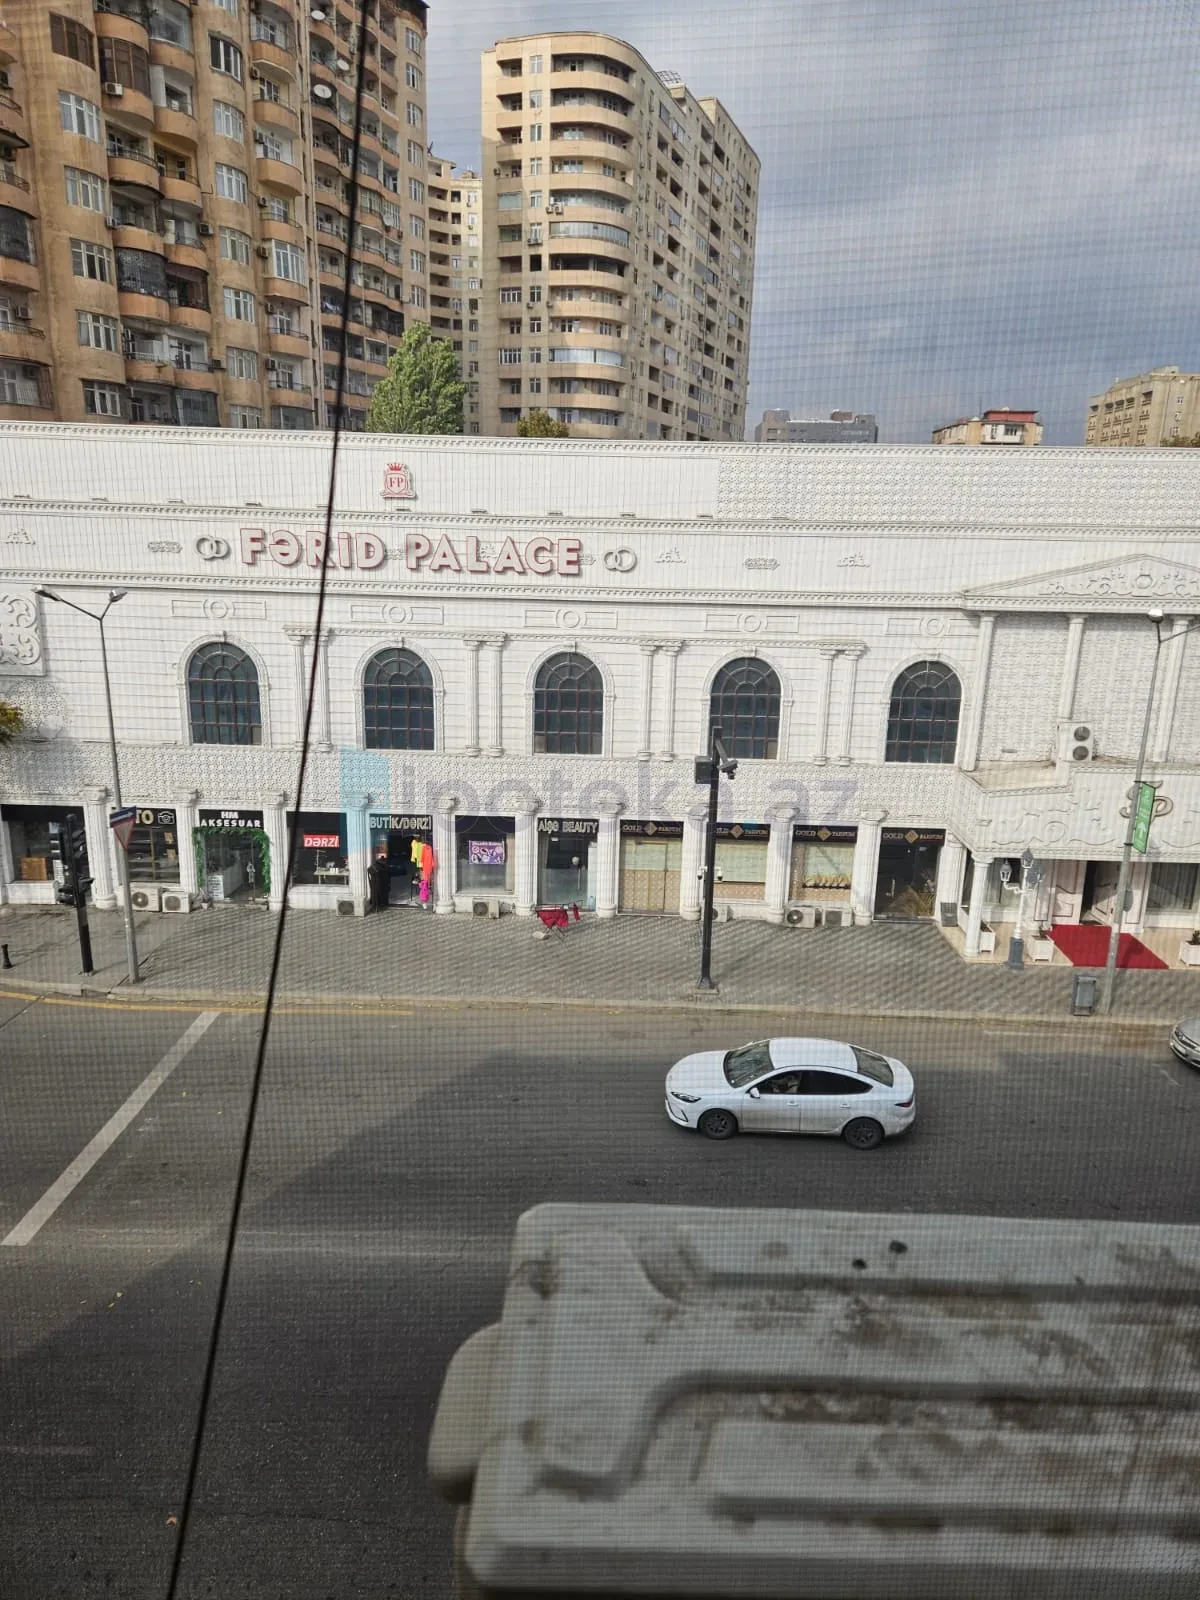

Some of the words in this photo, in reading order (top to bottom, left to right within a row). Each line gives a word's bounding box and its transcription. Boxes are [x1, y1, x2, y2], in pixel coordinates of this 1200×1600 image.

[389, 476, 405, 488] FP
[406, 533, 582, 575] PALACE
[220, 810, 240, 820] HM
[200, 818, 263, 829] AKSESUAR
[561, 820, 598, 834] BEAUTY
[622, 824, 643, 832] GOLD
